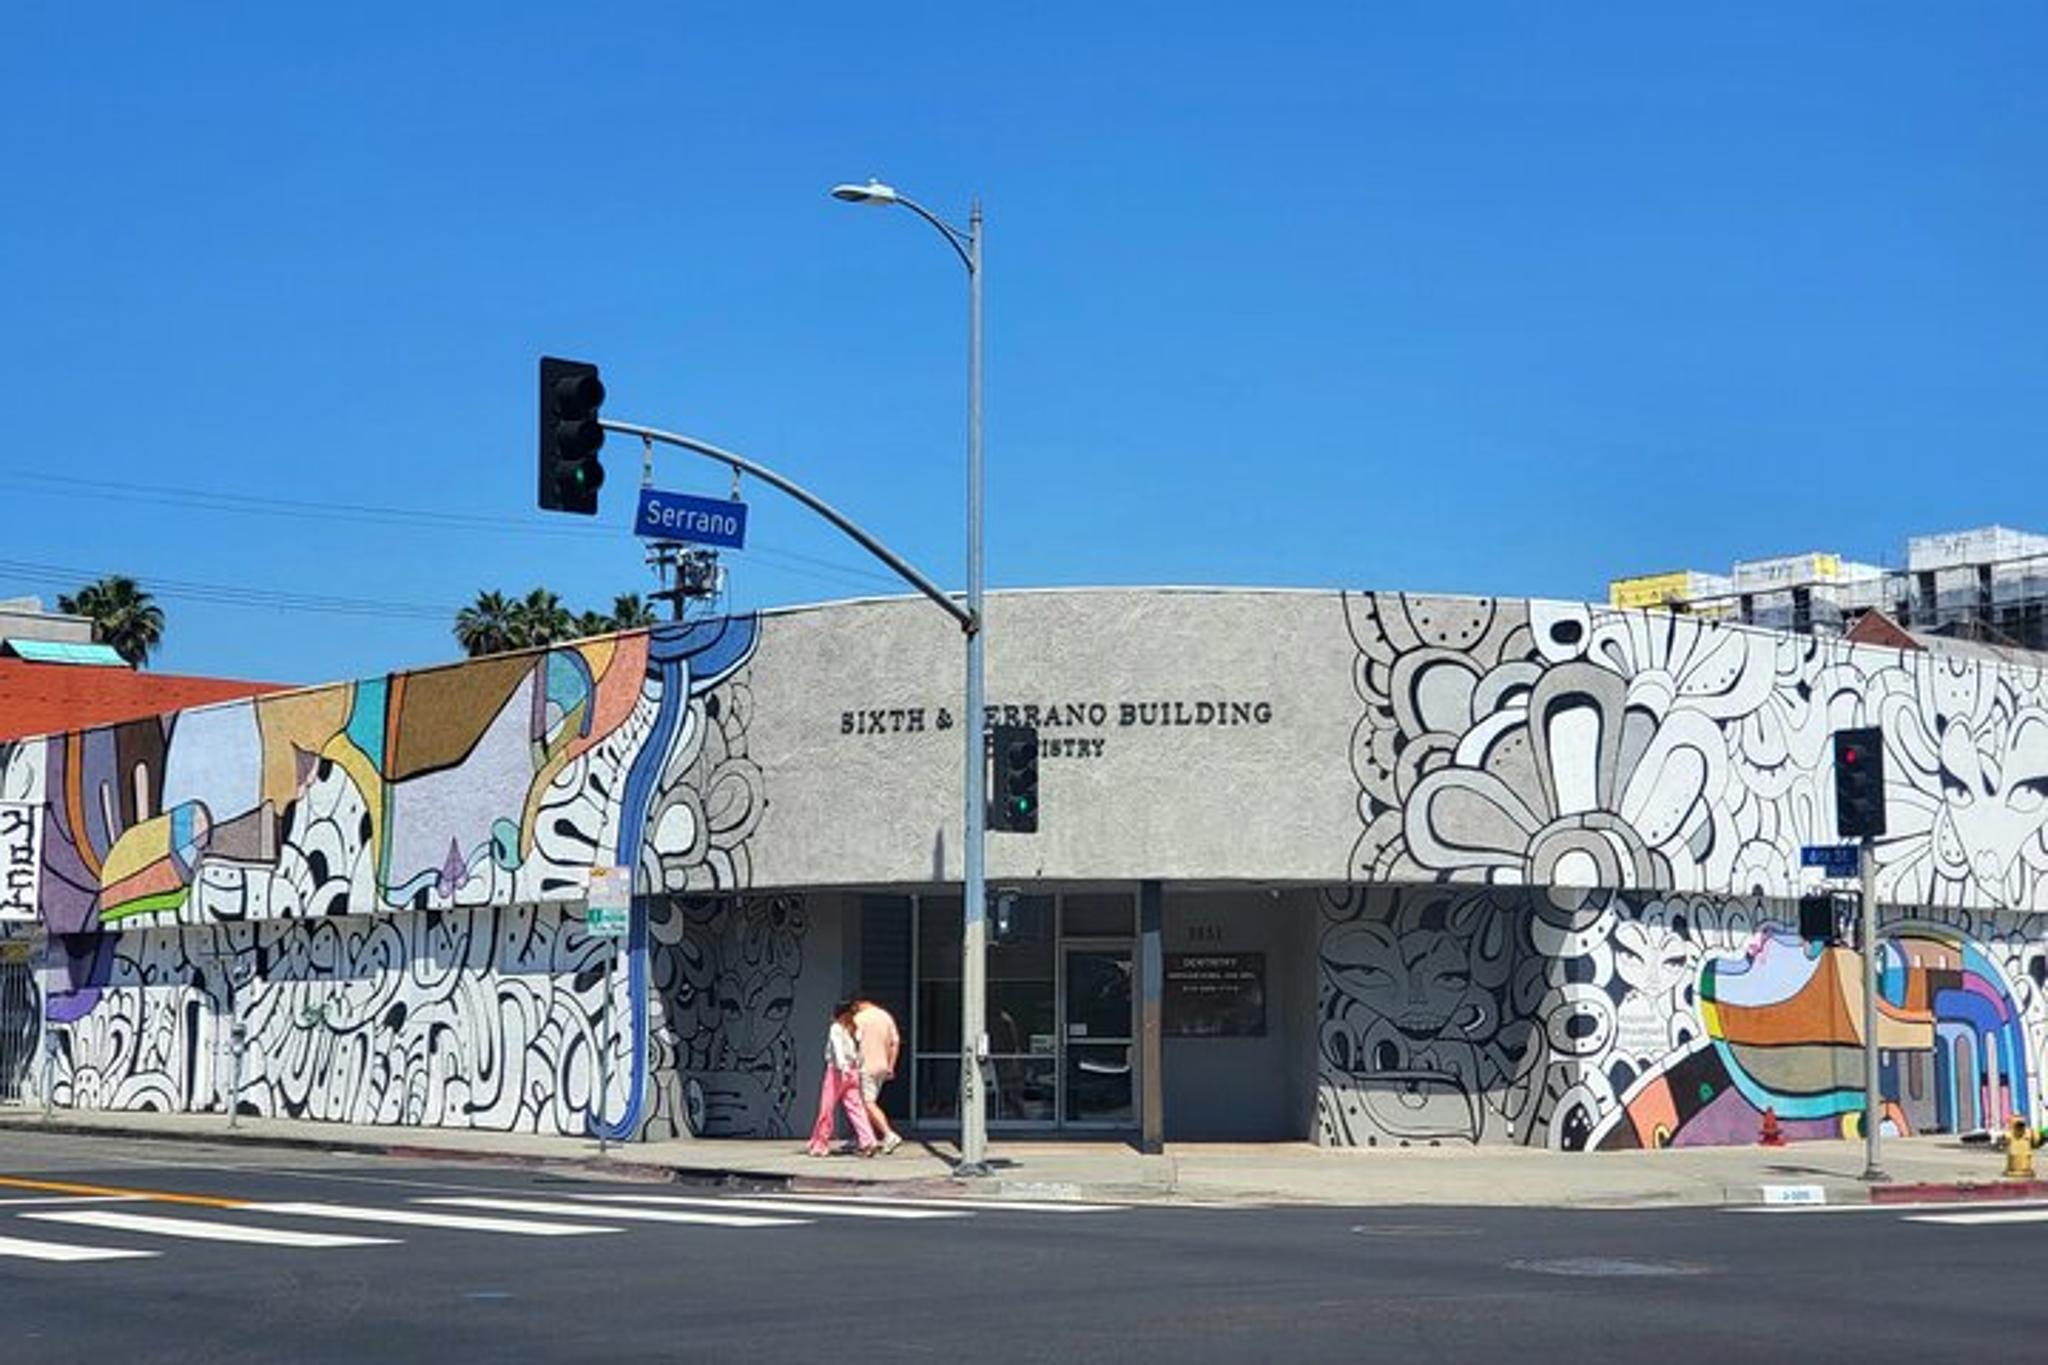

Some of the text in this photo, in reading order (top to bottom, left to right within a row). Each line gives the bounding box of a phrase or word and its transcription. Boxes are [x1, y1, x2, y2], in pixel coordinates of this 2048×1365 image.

[646, 499, 738, 536] Serrano
[841, 702, 1272, 734] SIXTH & ERRANO BUILDING
